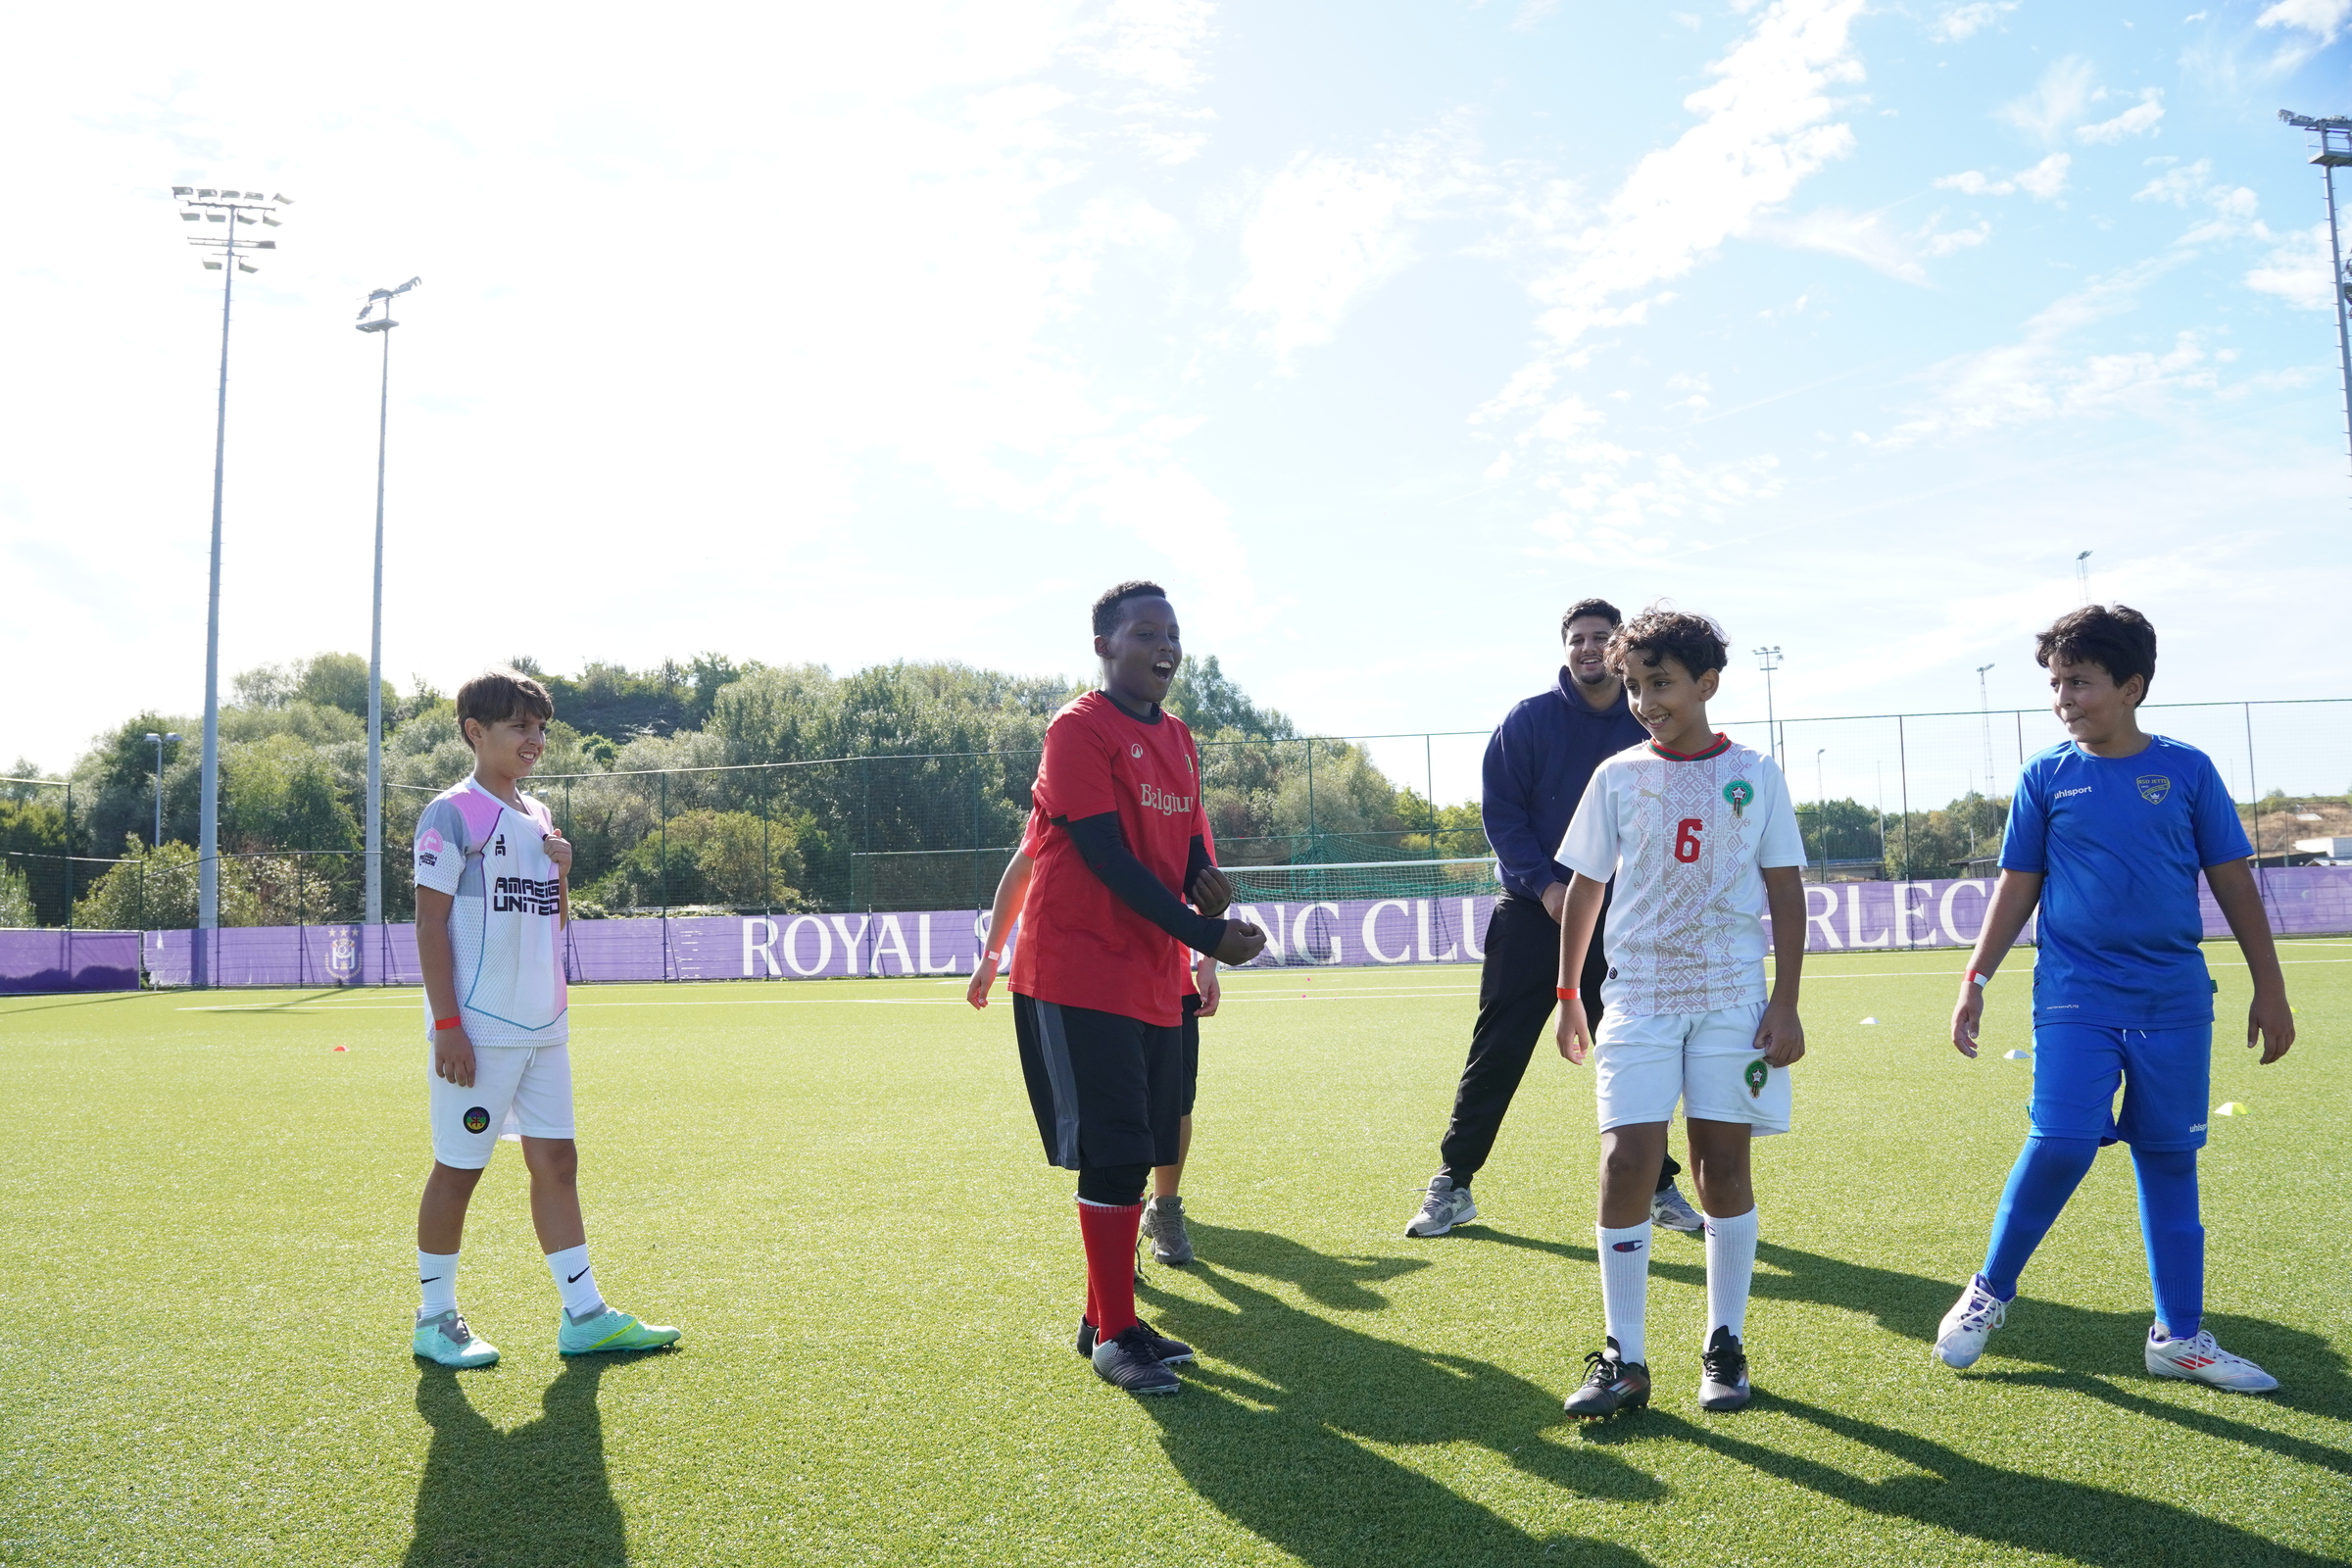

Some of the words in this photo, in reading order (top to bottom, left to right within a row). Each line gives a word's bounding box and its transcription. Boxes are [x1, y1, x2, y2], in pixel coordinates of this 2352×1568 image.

[1140, 783, 1193, 816] Belgiu
[2054, 786, 2092, 799] uhlsport
[1675, 818, 1703, 863] 6
[742, 913, 956, 976] ROYAL
[1361, 898, 1499, 964] CLU
[2189, 1123, 2207, 1133] uhlsp
